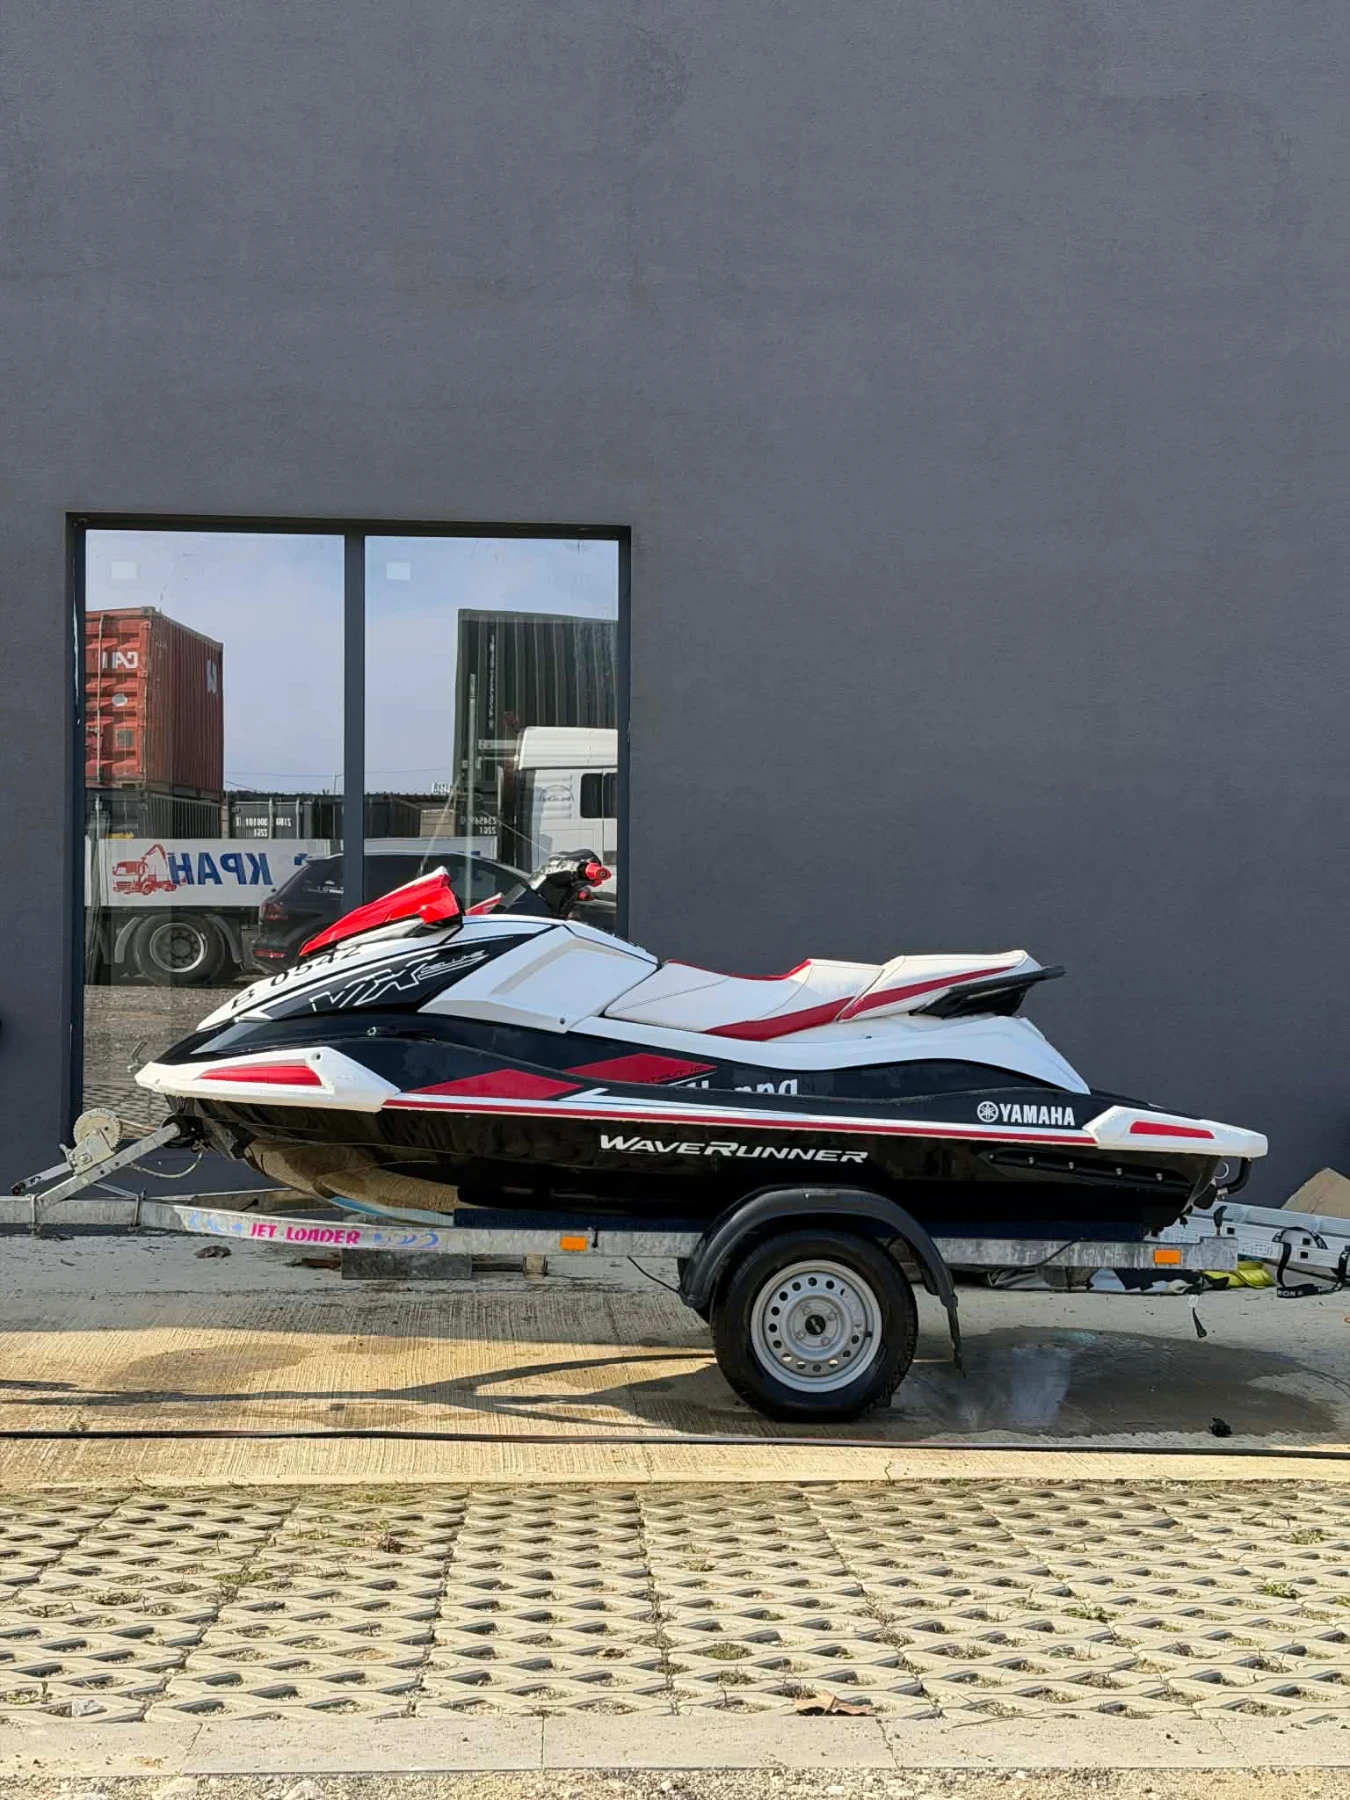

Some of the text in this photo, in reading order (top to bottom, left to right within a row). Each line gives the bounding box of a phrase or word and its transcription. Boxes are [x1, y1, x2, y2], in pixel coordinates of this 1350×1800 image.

[999, 1103, 1076, 1126] YAMAHA
[600, 1134, 869, 1163] WAVERUNNER
[250, 1223, 361, 1244] JET LOADER
